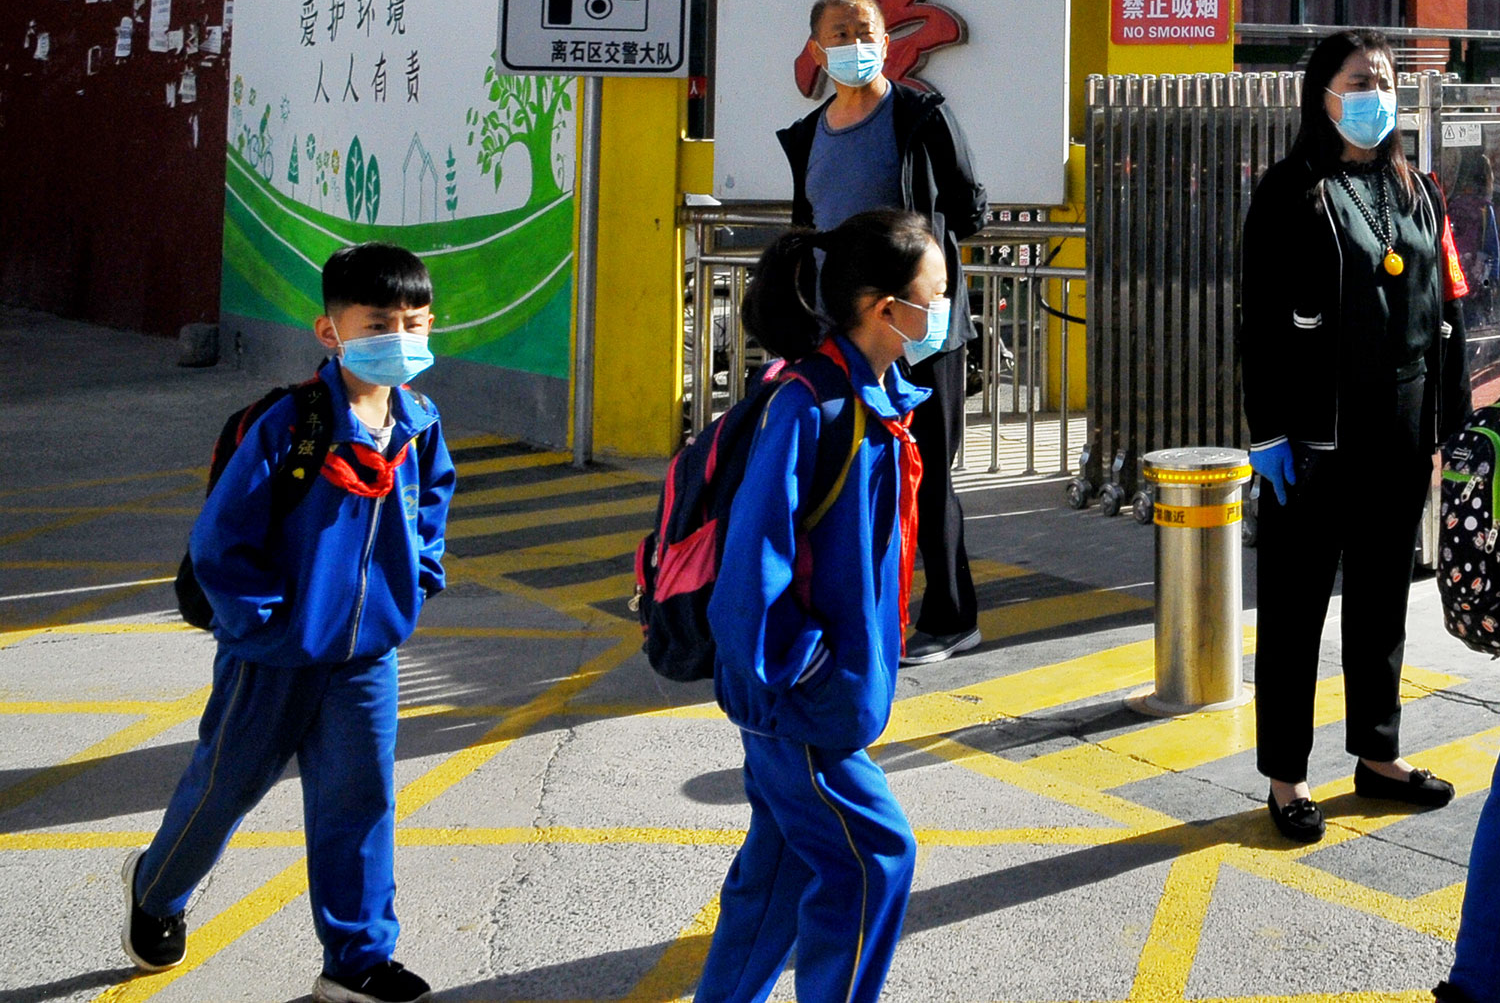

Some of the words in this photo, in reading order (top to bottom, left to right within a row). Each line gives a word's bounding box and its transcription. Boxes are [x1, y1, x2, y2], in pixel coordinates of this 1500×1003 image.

[551, 38, 674, 66] 离石区交警大队
[1123, 26, 1145, 39] NO
[1148, 25, 1216, 39] SMOKING
[313, 49, 420, 103] 人人有责
[297, 390, 322, 457] 少年强
